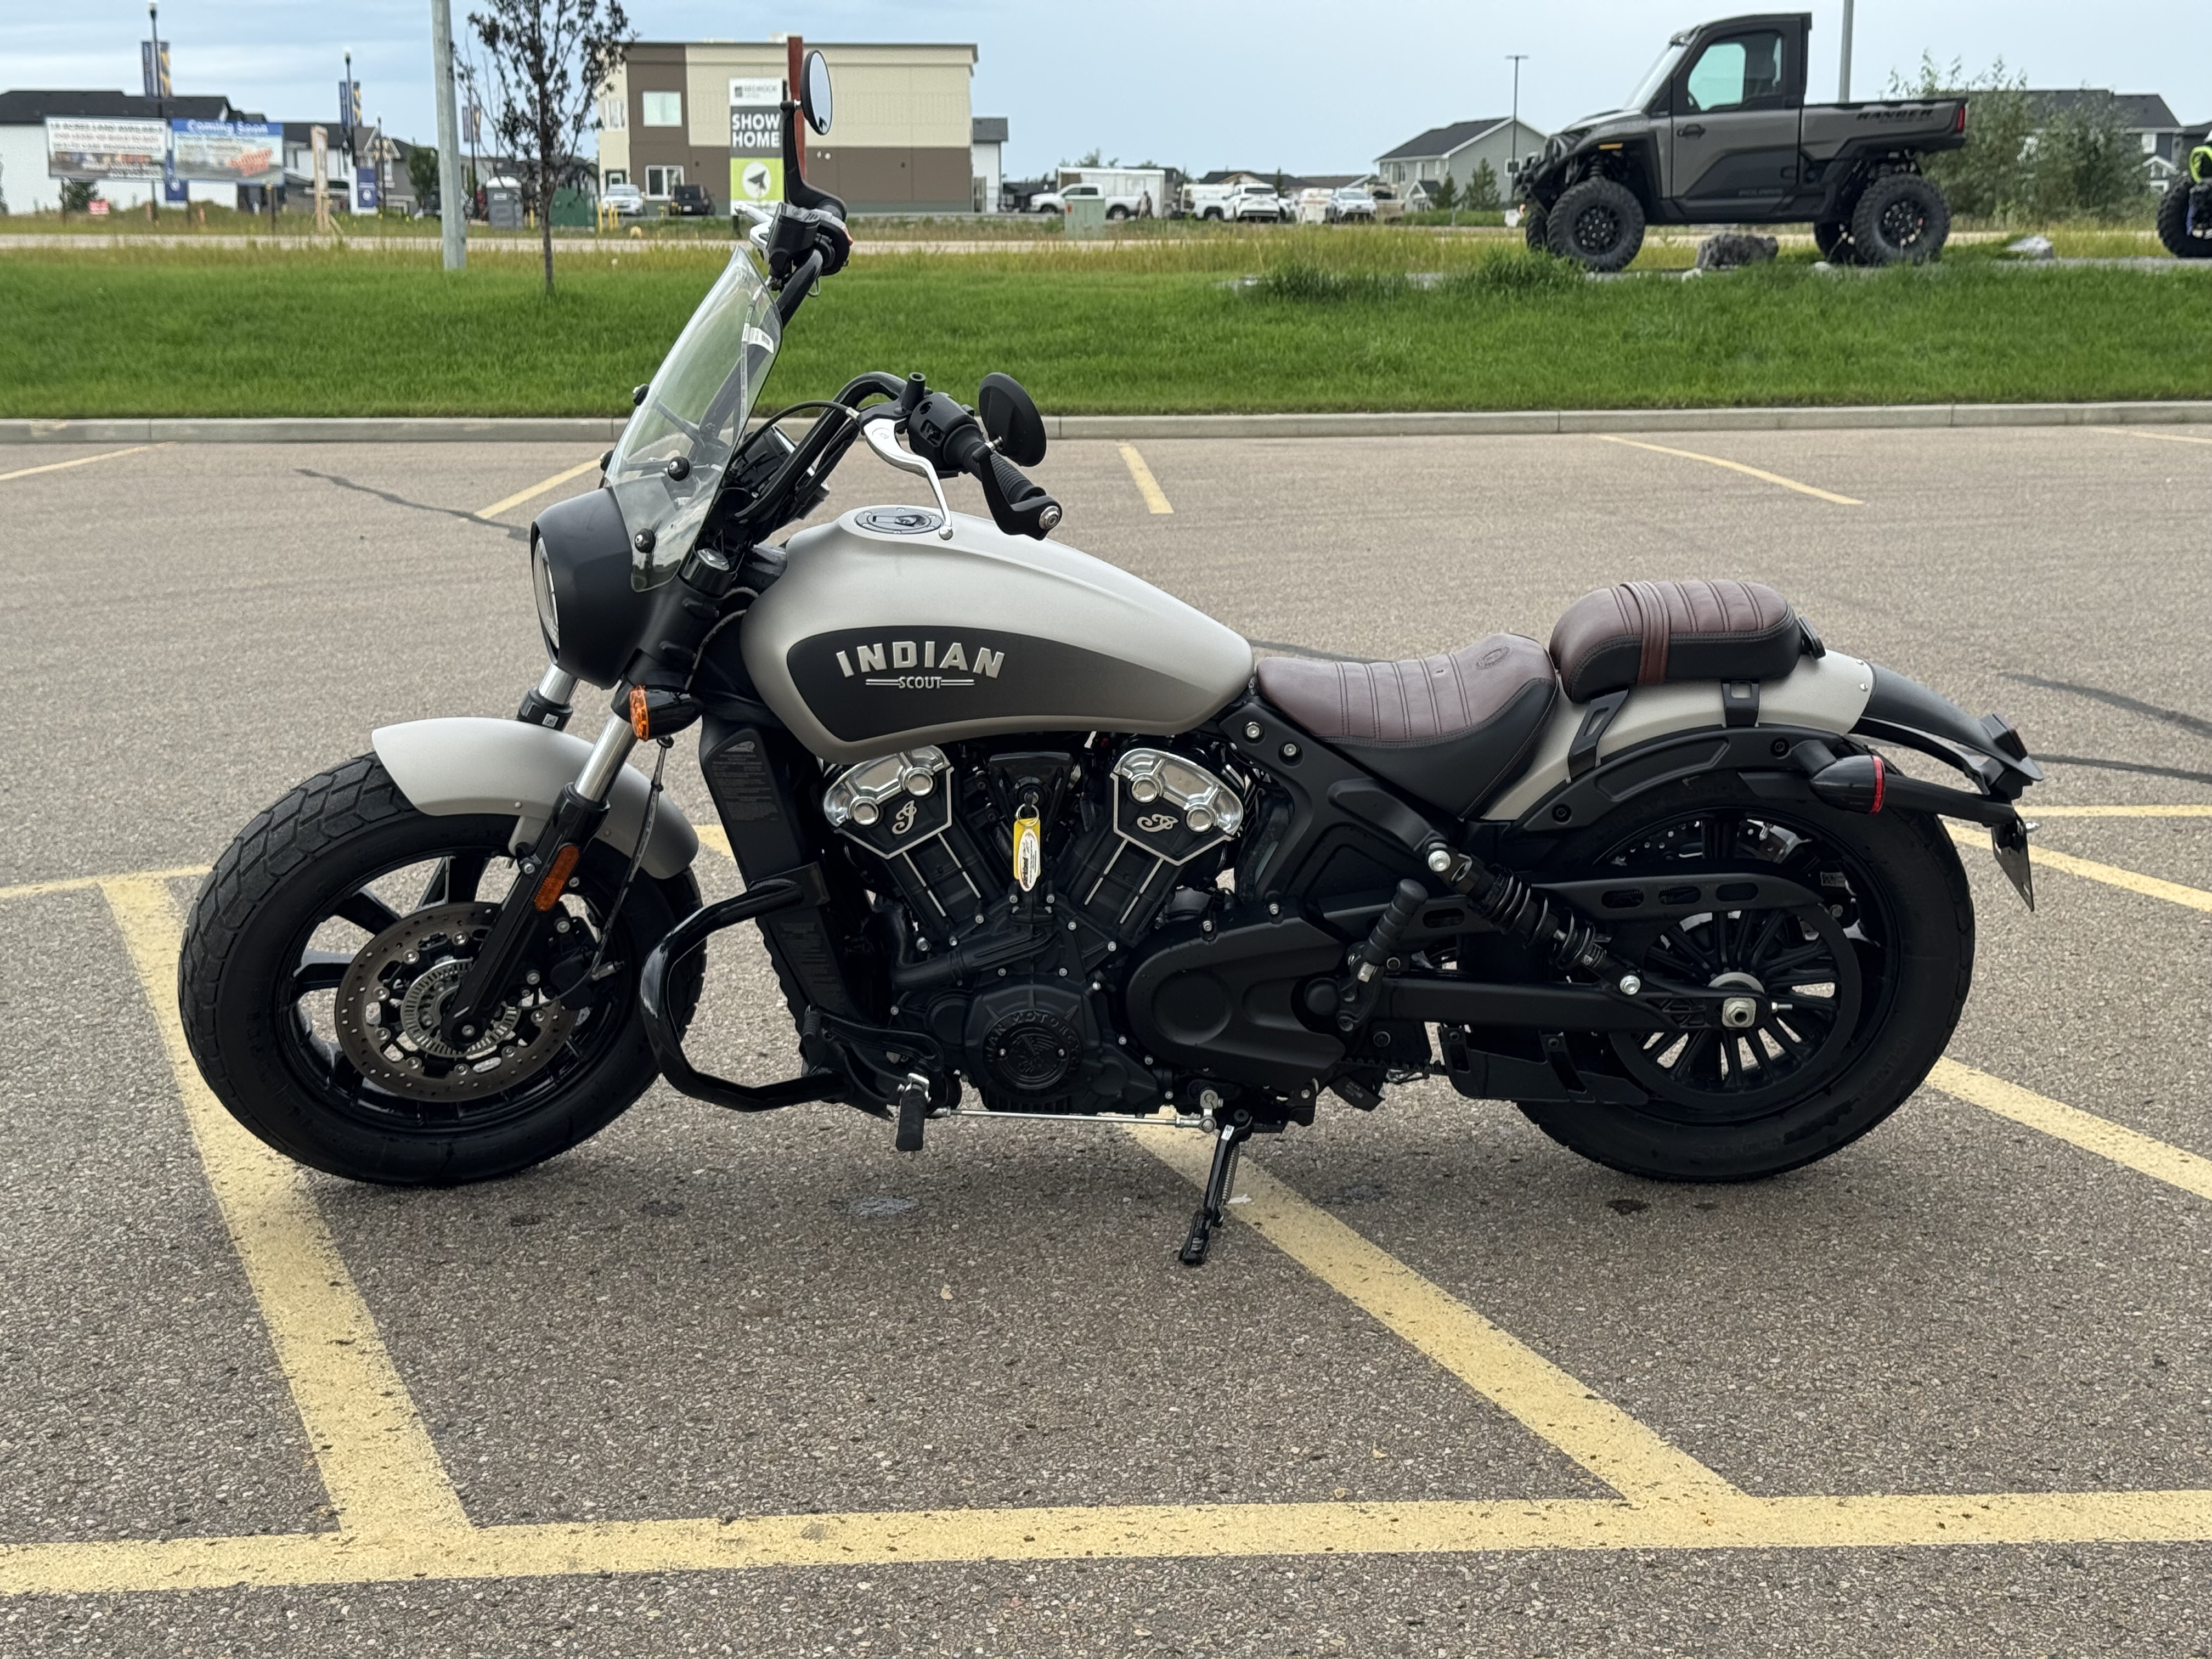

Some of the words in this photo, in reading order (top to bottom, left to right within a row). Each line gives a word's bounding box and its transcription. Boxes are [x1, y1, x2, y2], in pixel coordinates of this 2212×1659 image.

[187, 119, 234, 136] Coming
[236, 121, 269, 134] Soon
[732, 113, 781, 131] SHOW
[732, 131, 781, 148] HOME
[835, 640, 1006, 679] INDIAN
[898, 675, 943, 690] SCOUT
